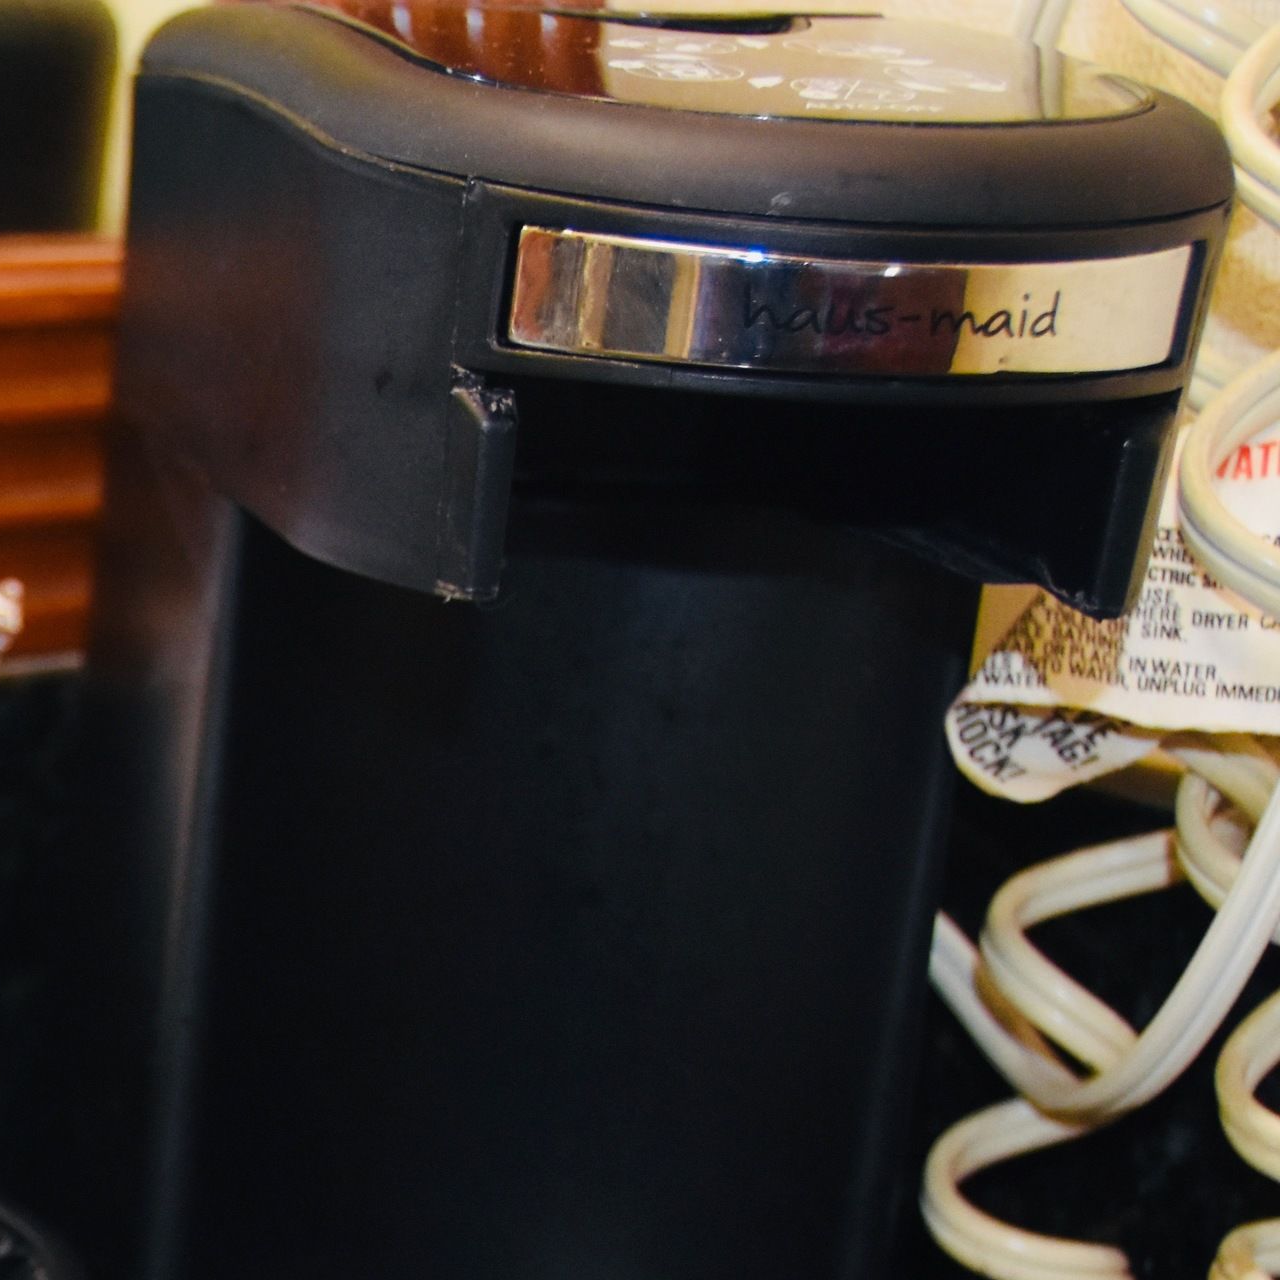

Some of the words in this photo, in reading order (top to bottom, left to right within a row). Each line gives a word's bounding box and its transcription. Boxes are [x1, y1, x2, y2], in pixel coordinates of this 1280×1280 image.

[743, 282, 1061, 338] haus-maid
[1191, 609, 1249, 630] DRYER
[1129, 656, 1147, 673] IN
[1137, 675, 1207, 697] UNPLUG
